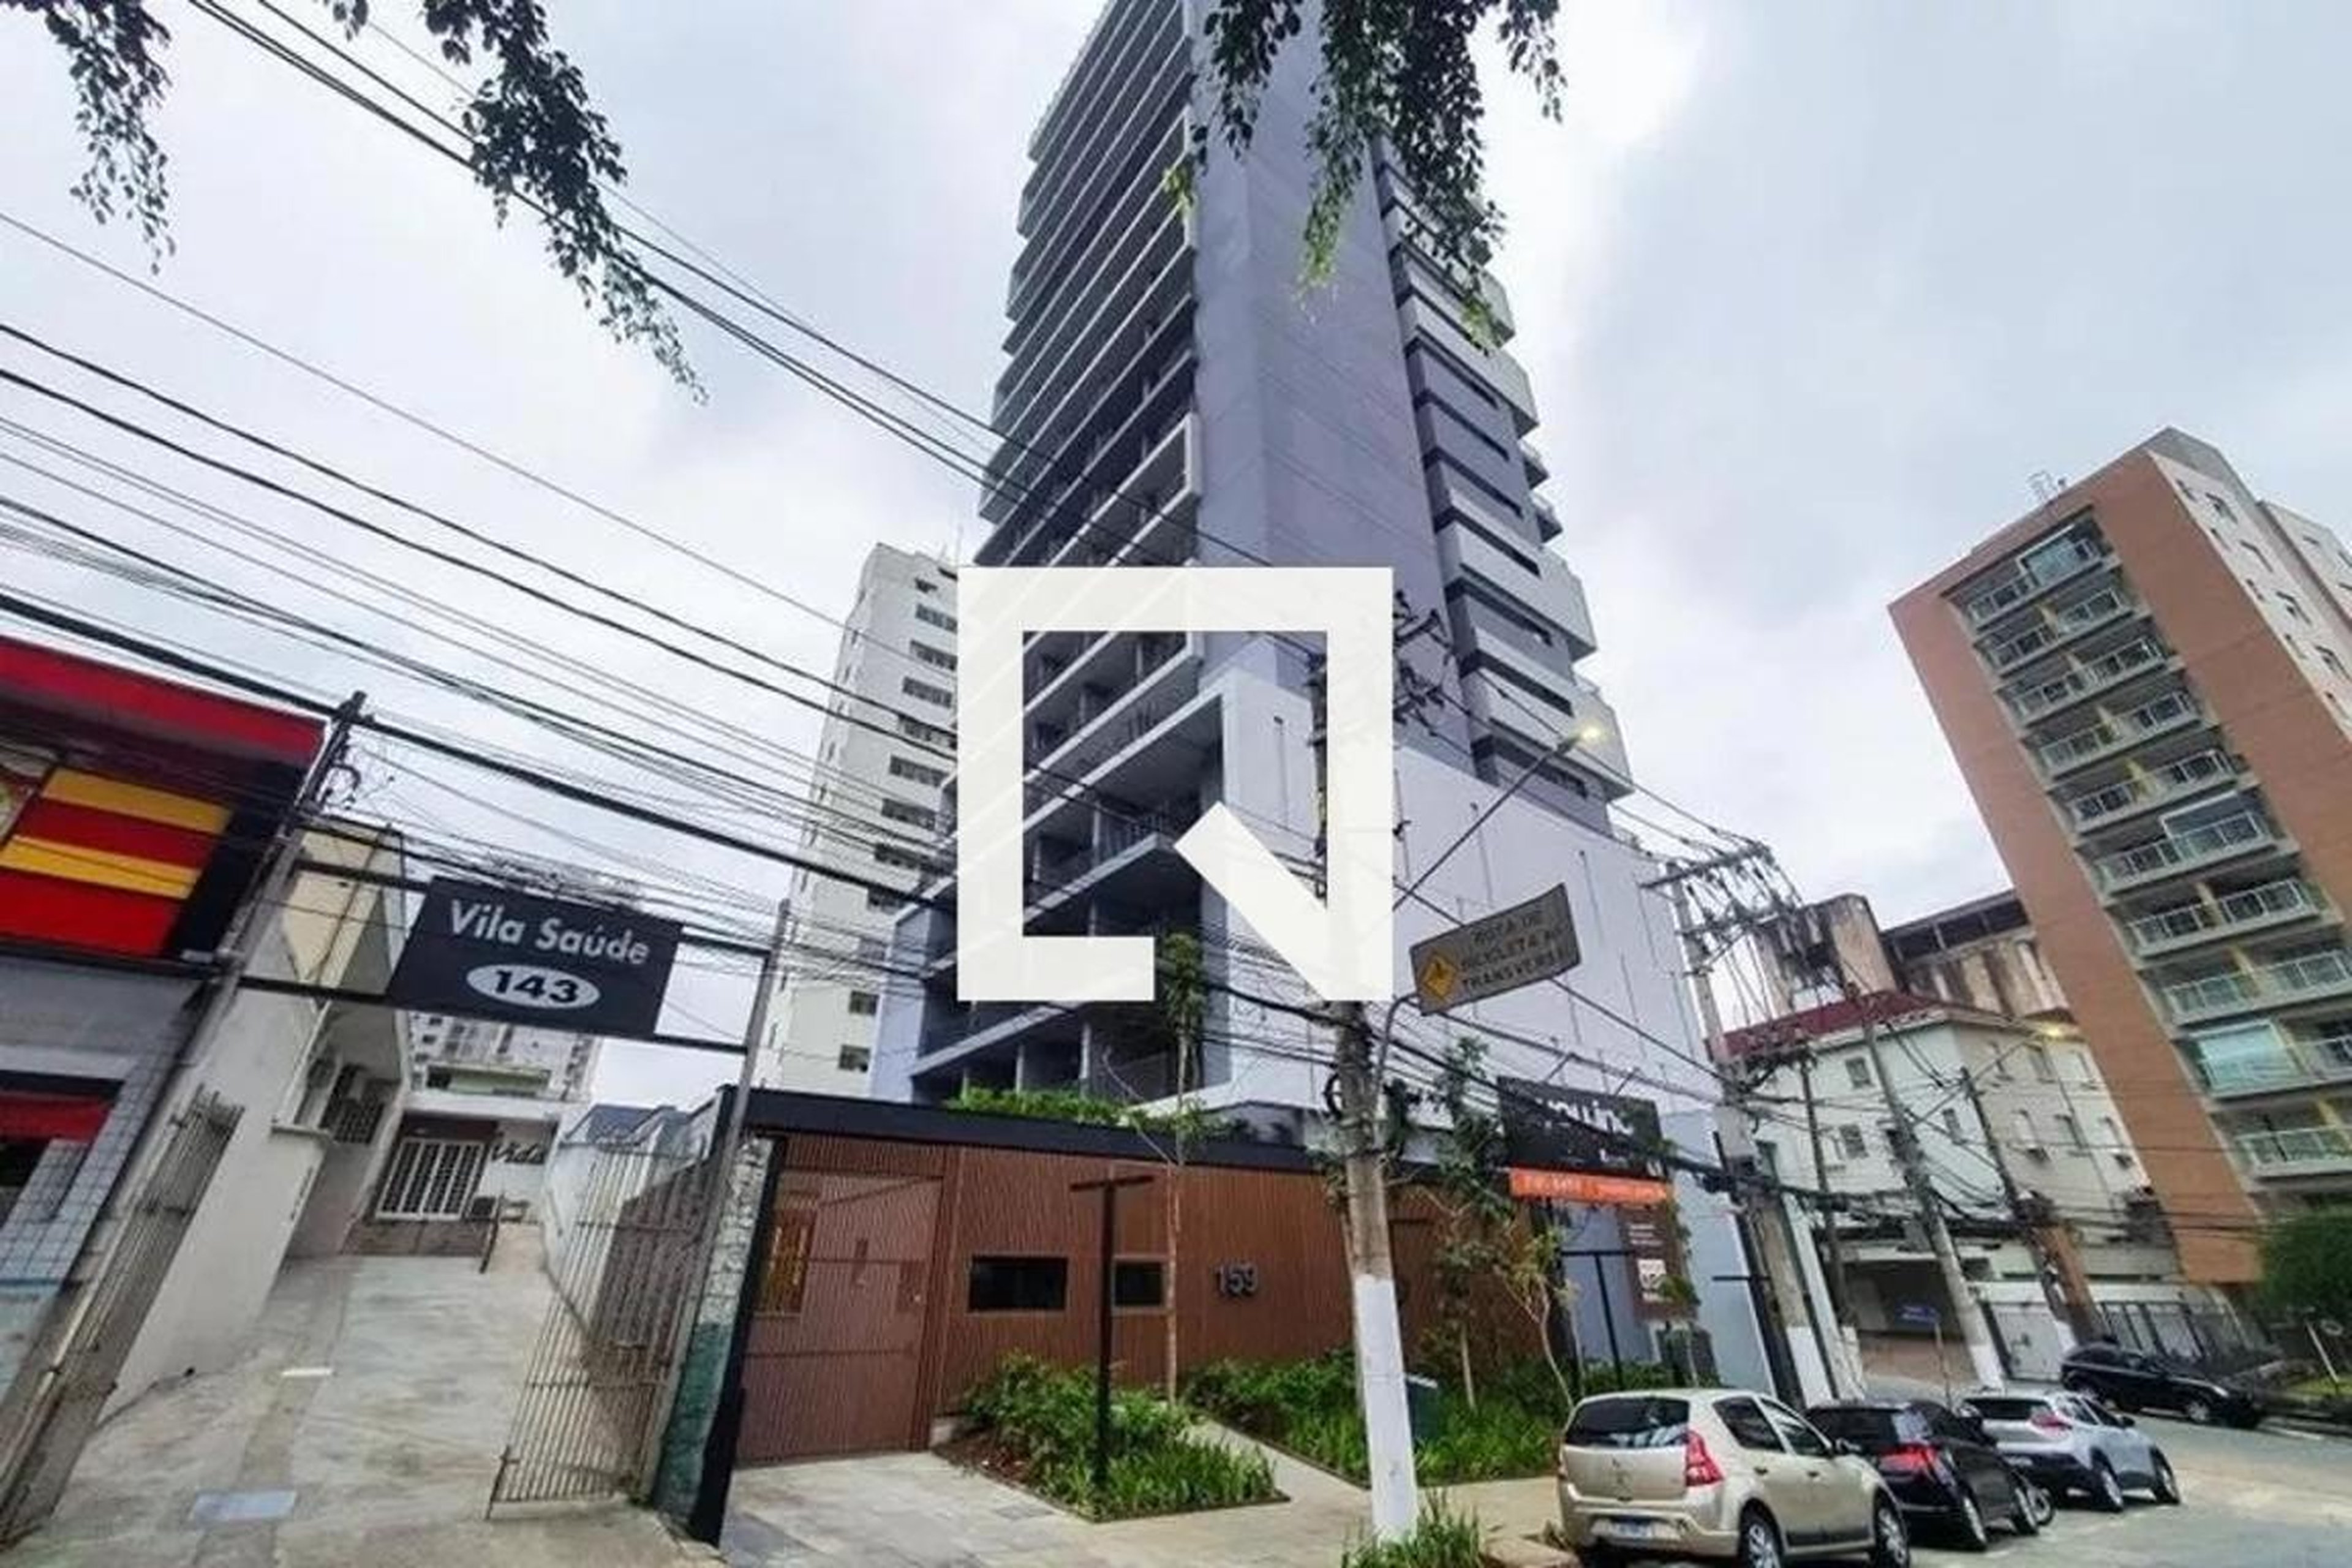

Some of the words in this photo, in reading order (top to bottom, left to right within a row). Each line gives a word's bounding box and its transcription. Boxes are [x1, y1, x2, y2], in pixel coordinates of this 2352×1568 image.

[450, 899, 526, 946] Vila
[535, 918, 650, 965] Saúde
[494, 970, 579, 1003] 143
[1215, 1262, 1259, 1293] 159
